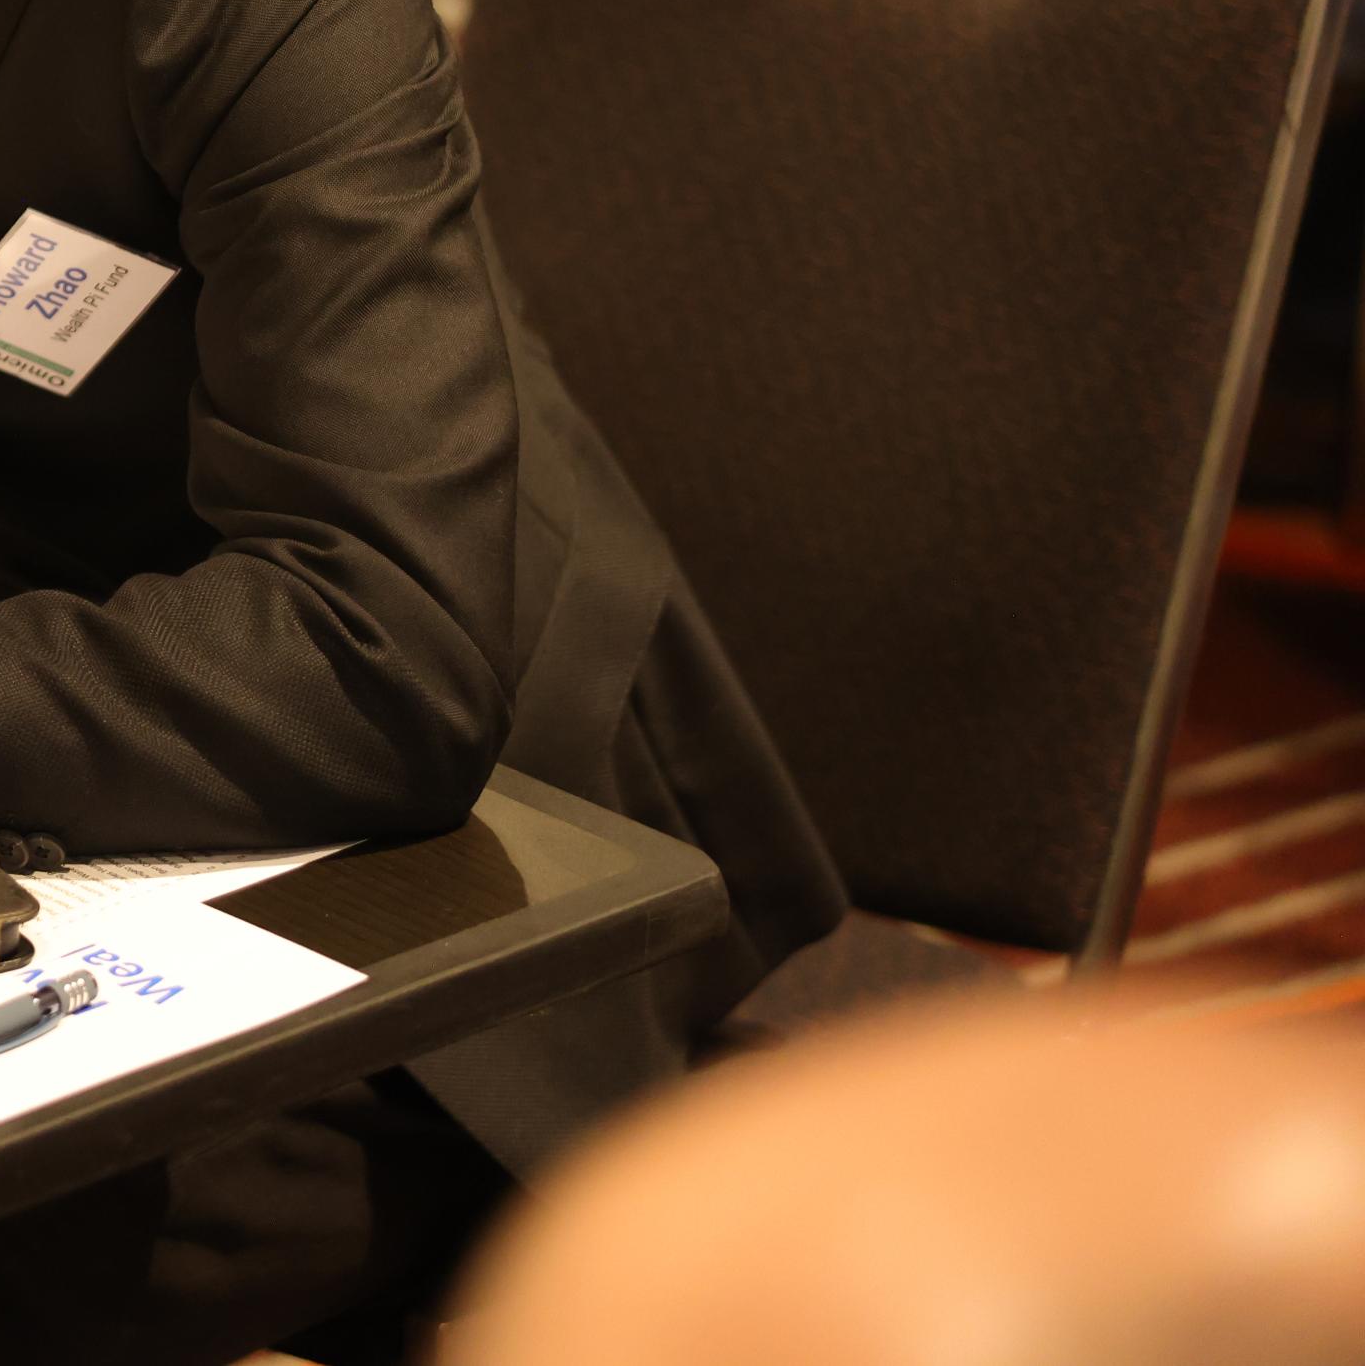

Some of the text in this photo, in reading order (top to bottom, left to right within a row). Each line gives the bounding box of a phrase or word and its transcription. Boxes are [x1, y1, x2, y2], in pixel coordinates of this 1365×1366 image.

[25, 266, 88, 321] Zhao
[50, 264, 129, 344] Wealth Pi Fund
